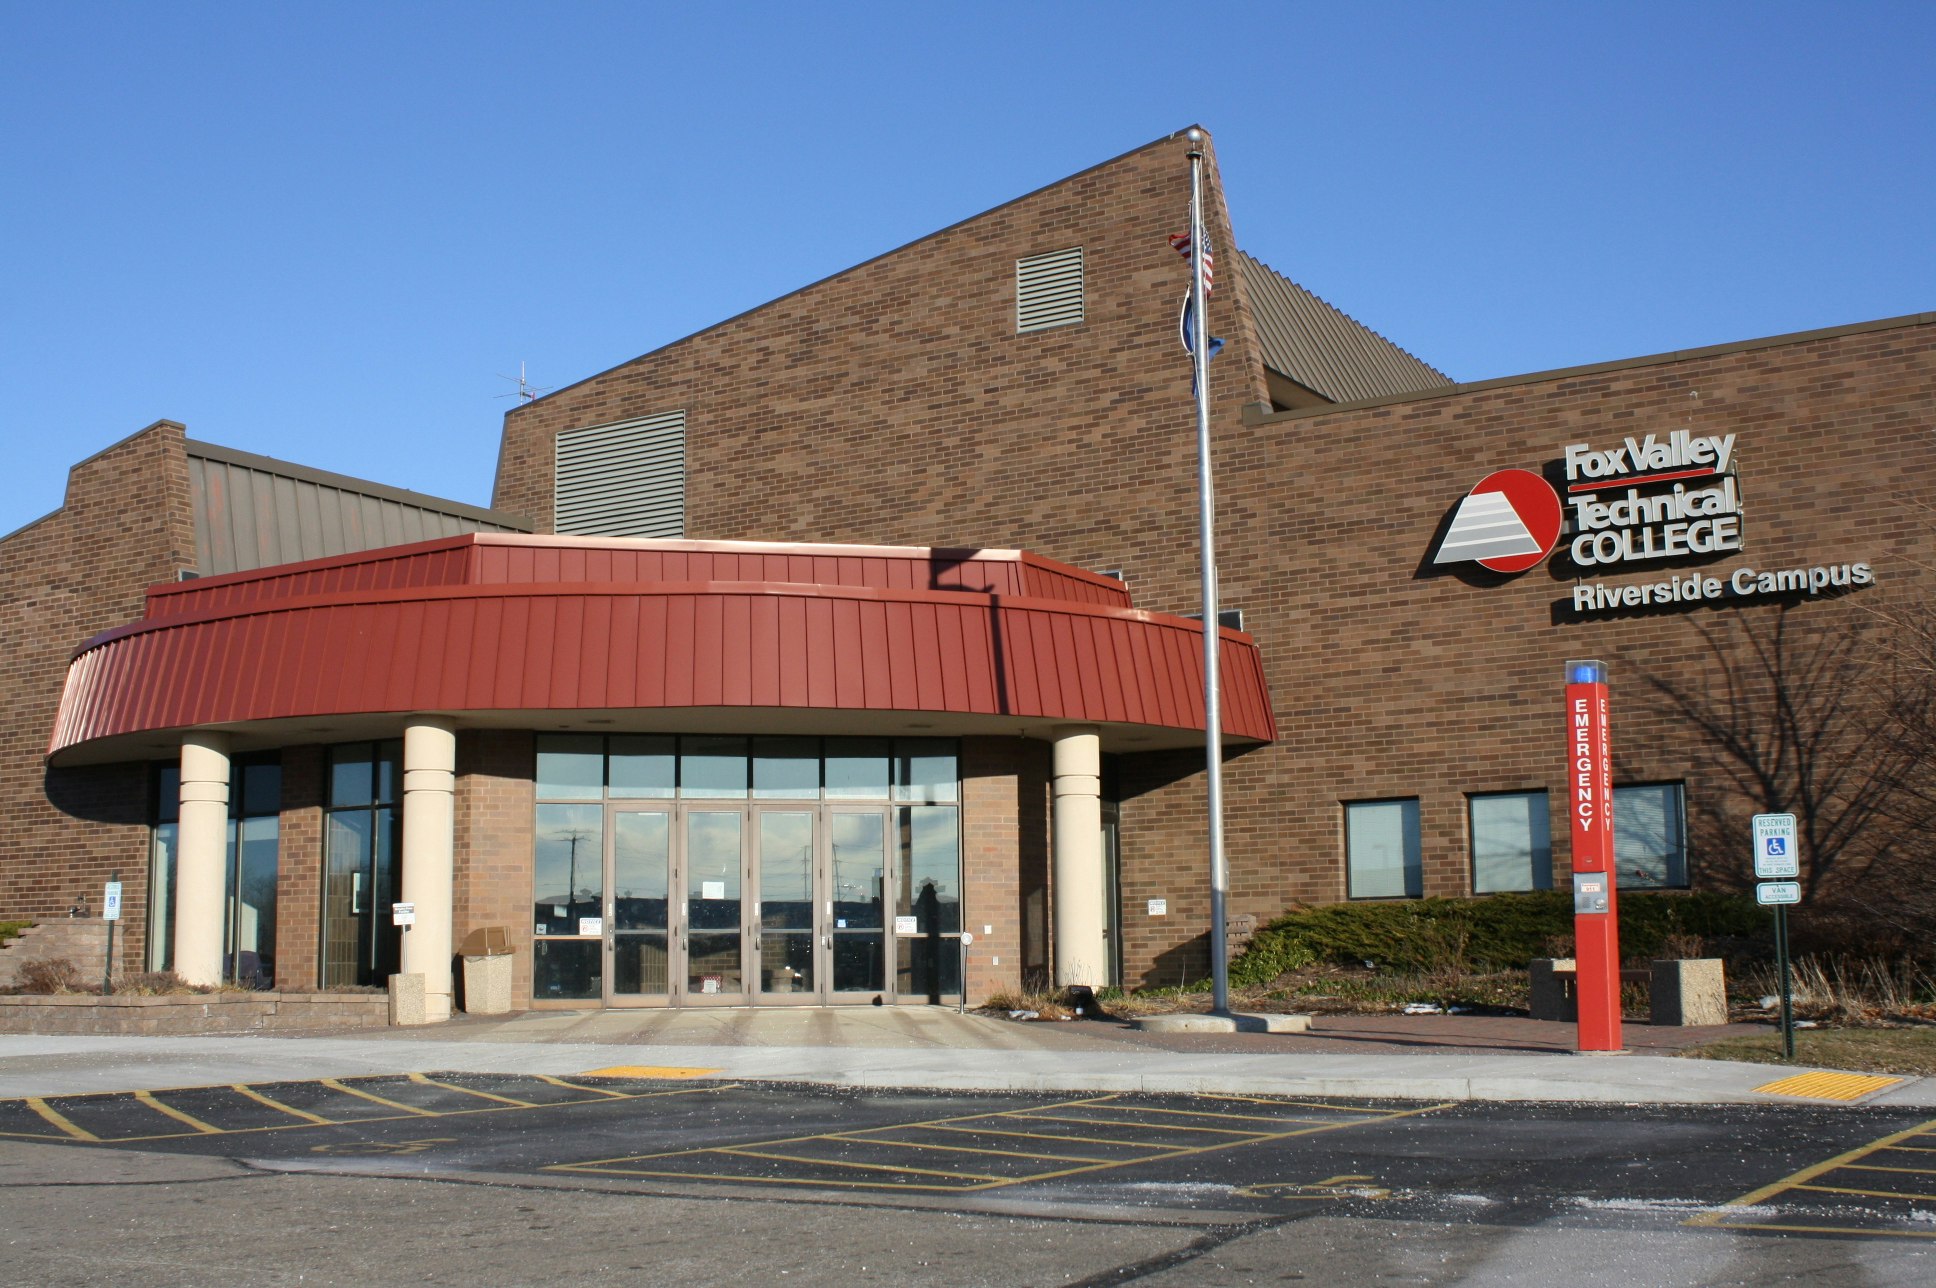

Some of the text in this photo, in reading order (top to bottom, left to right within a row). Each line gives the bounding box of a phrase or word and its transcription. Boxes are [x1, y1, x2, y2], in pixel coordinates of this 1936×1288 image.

[1565, 429, 1736, 480] Fox Valley
[1568, 476, 1736, 531] Technical
[1571, 516, 1740, 566] COLLEGE
[1574, 562, 1872, 611] Riverside Campus
[1575, 699, 1593, 832] EMERGENCY
[1600, 698, 1610, 832] EMERGENCY
[1758, 818, 1791, 827] RESERVED
[1760, 828, 1790, 836] PARKING
